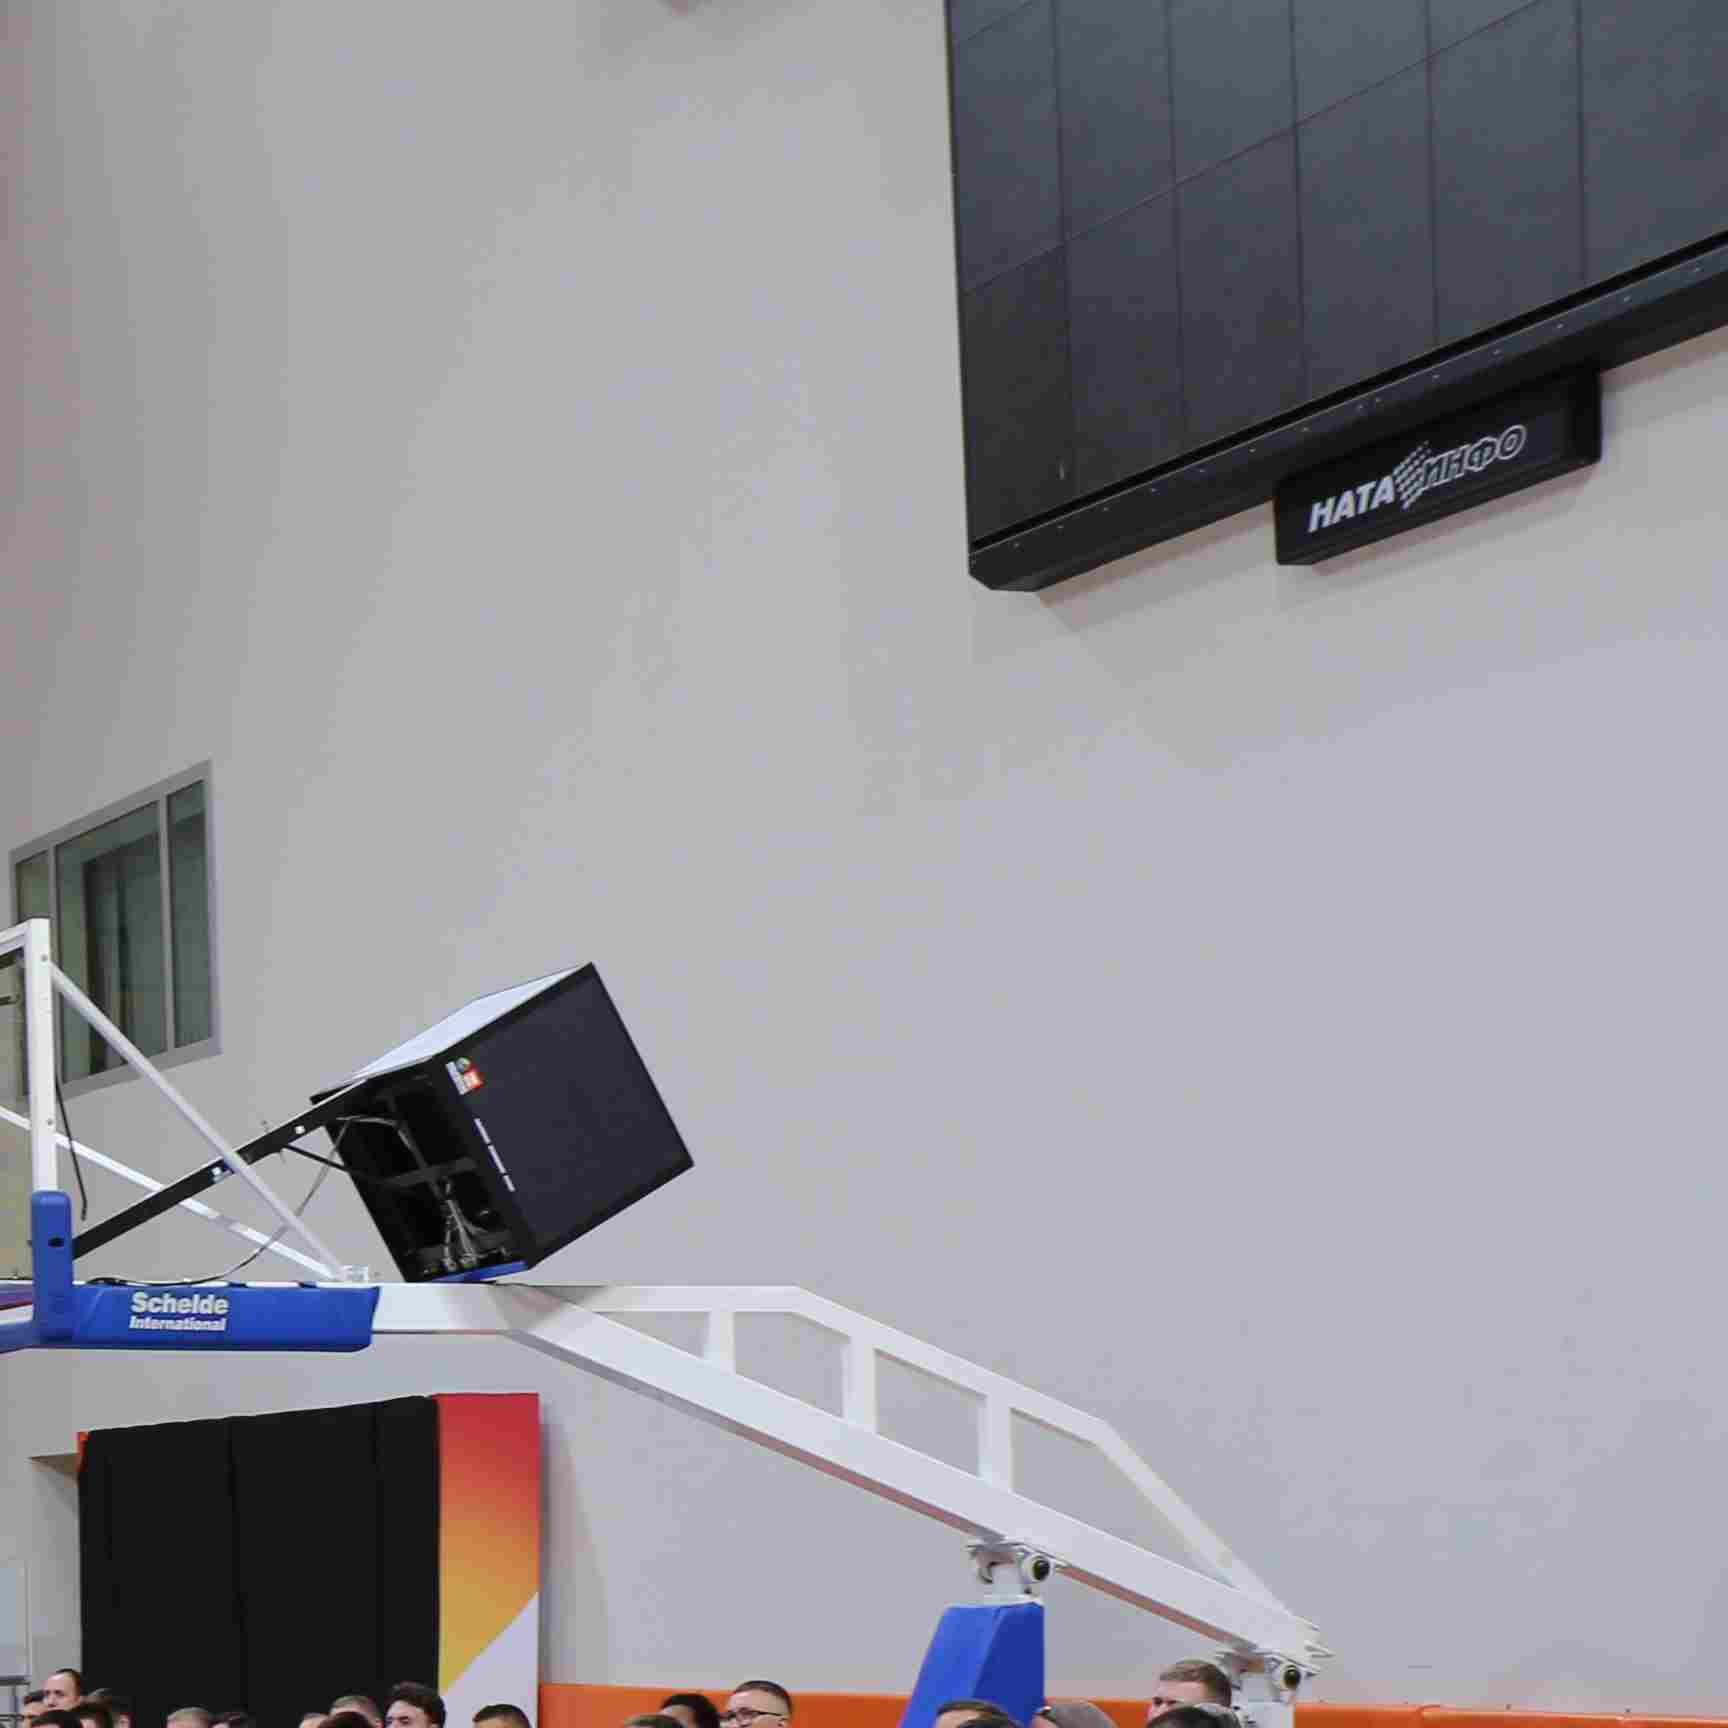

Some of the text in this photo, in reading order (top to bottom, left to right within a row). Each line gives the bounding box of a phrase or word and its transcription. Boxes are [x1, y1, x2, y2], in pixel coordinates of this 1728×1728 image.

[1308, 475, 1395, 533] НАТА
[131, 1291, 229, 1314] Schelde
[129, 1315, 227, 1331] International
